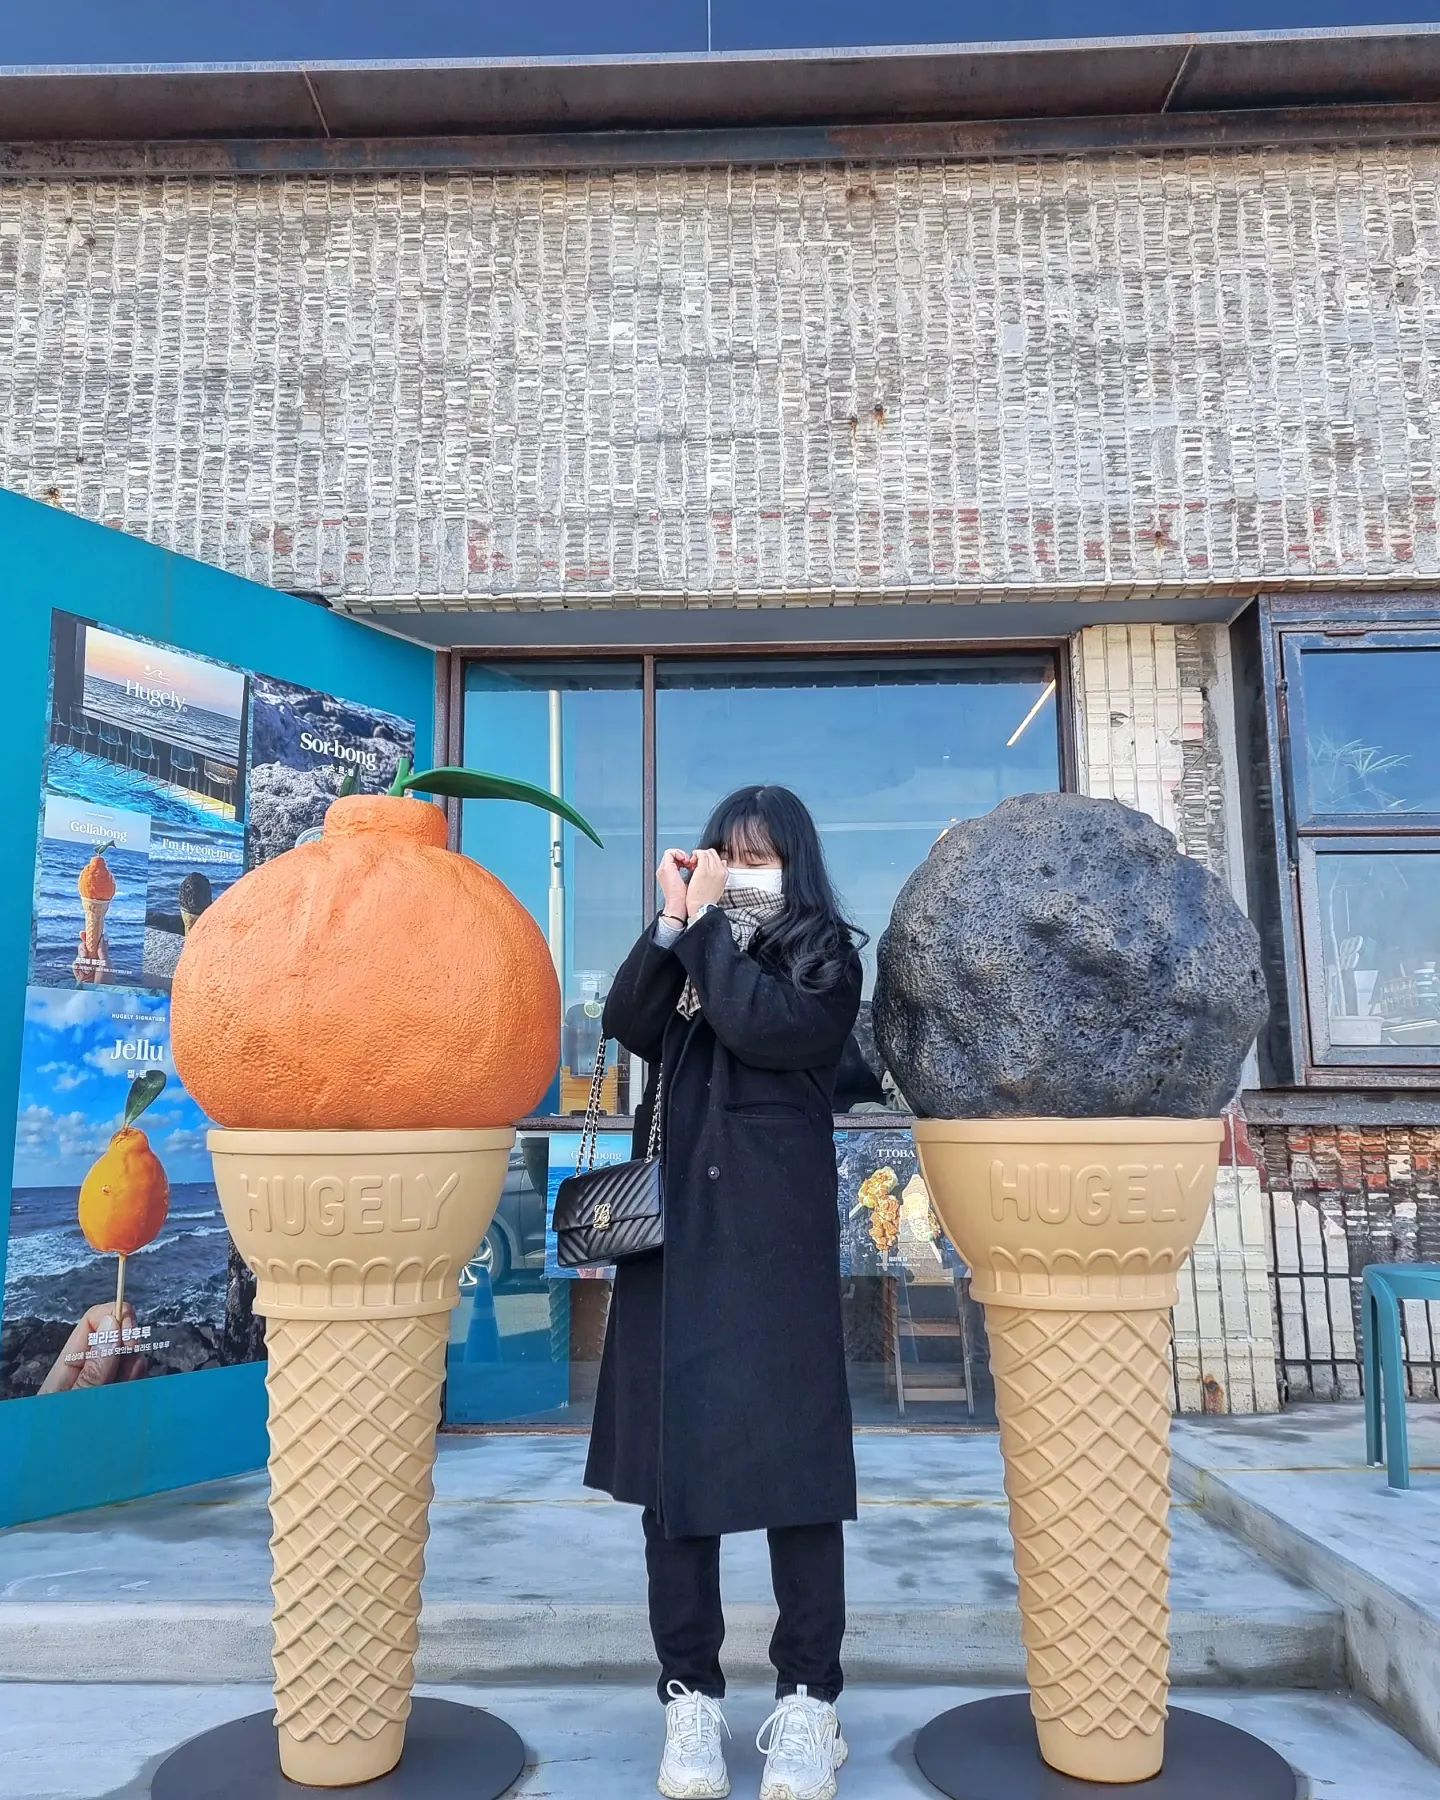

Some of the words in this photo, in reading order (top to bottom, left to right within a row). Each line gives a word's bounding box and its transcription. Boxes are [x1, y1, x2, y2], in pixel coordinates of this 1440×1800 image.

[125, 679, 186, 713] Hugely
[300, 732, 377, 771] Sor-bong
[70, 821, 128, 843] Gellabong
[162, 838, 179, 849] I'm
[135, 1014, 166, 1022] SIGNATURE
[110, 1039, 163, 1061] Jellu
[877, 1149, 916, 1158] TTOBA
[988, 1159, 1205, 1226] HUGELY
[240, 1171, 460, 1237] HUGELY
[87, 1330, 120, 1346] 젤라또
[121, 1325, 152, 1341] 탕후루
[114, 1346, 133, 1355] 맛있는
